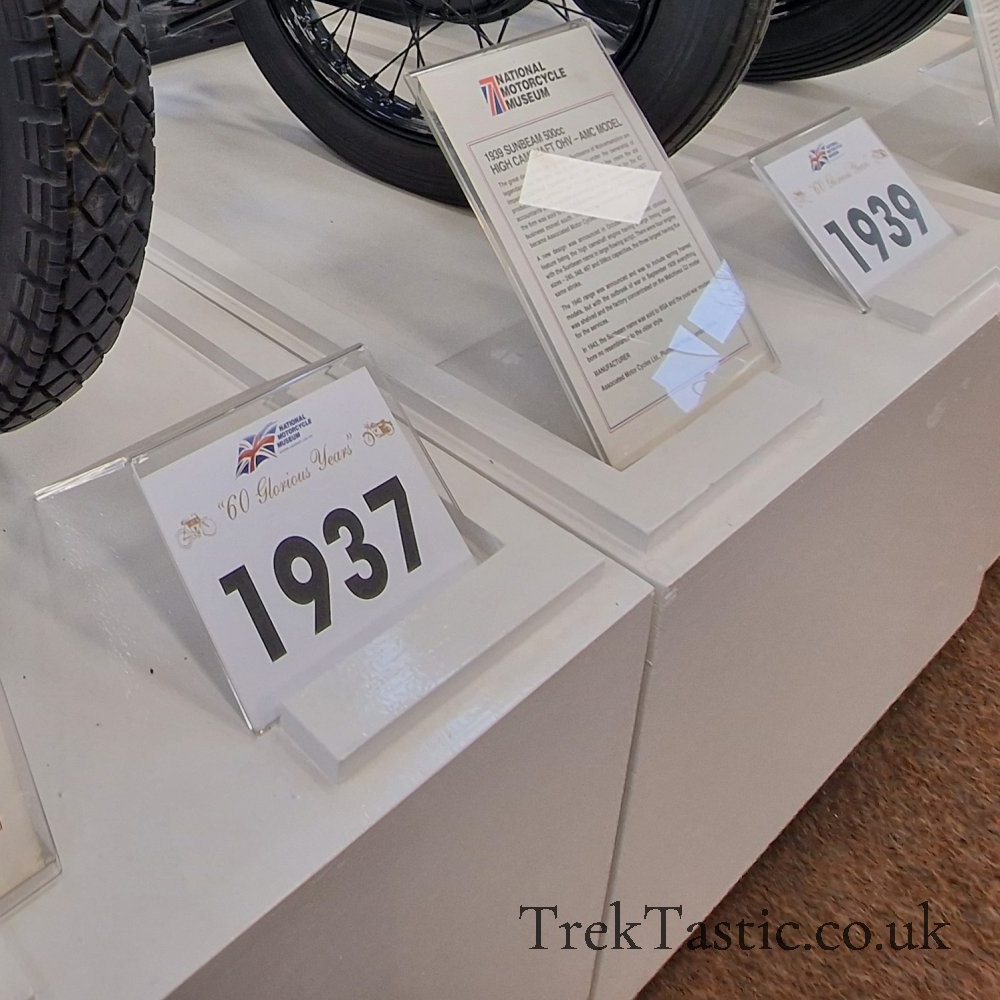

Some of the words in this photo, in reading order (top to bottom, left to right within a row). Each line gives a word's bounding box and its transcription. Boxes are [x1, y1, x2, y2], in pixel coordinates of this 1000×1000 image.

[494, 61, 546, 85] NATIONAL
[500, 67, 567, 97] MOTORCYCLE
[504, 87, 551, 110] MUSEUM
[484, 147, 504, 162] 1939
[503, 133, 543, 155] SUNBEAM
[490, 160, 512, 175] HIGH
[512, 142, 555, 167] CAMAFT
[555, 136, 574, 150] OHV
[578, 126, 597, 142] AMC
[596, 118, 623, 134] MODEL
[823, 183, 928, 273] 1939
[277, 418, 312, 440] MOTORCYCLE
[278, 414, 306, 431] NATIONAL
[277, 432, 301, 448] MUSEUM
[256, 467, 311, 504] Glorious
[219, 475, 422, 662] 1937
